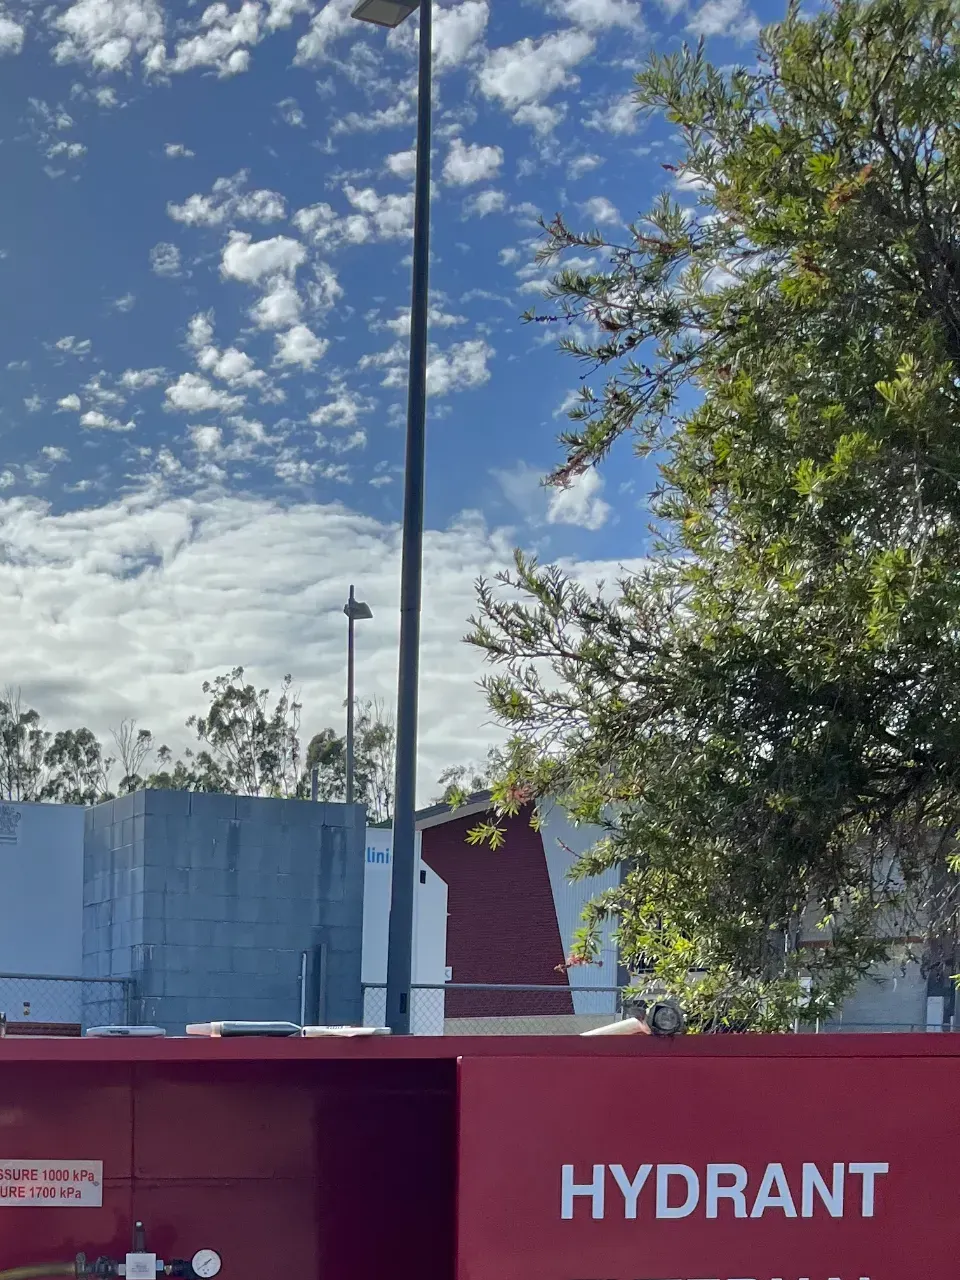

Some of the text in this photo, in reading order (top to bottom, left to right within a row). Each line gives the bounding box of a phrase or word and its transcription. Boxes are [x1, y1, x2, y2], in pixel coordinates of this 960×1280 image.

[366, 846, 392, 864] lini
[42, 1169, 70, 1182] 1000
[73, 1170, 95, 1182] kPa
[29, 1187, 56, 1199] 1700
[60, 1187, 82, 1199] kPa
[560, 1162, 889, 1220] HYDRANT
